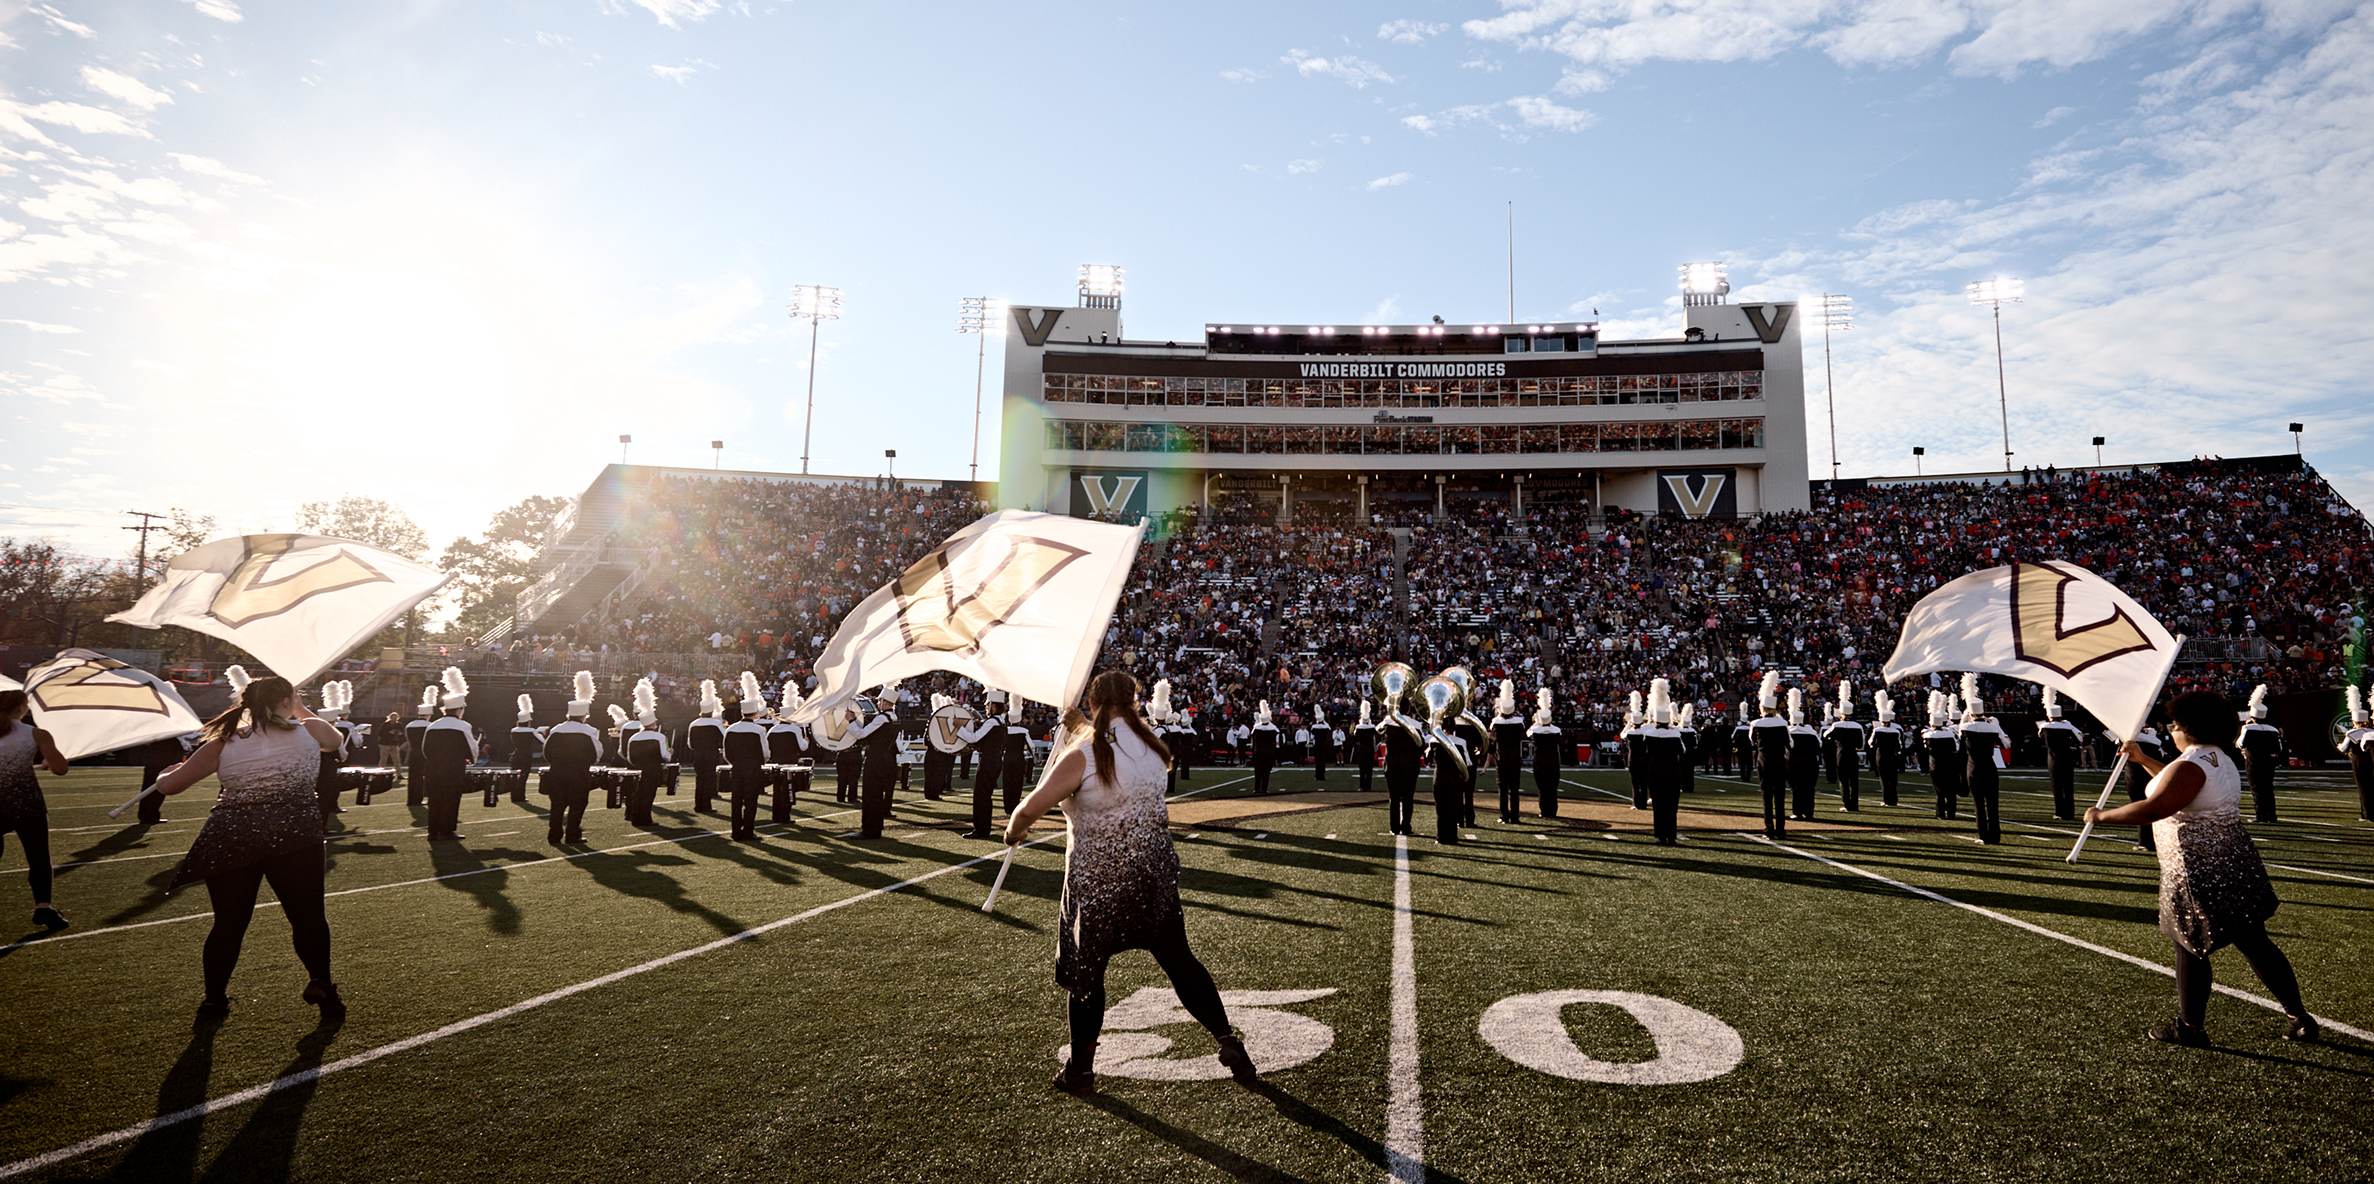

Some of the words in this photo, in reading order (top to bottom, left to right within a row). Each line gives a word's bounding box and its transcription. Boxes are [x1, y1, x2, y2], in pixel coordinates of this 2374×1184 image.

[1012, 308, 1064, 346] V
[1741, 304, 1796, 343] V
[1300, 363, 1393, 377] VANDERBILT
[1397, 362, 1506, 377] COMMODORES
[1080, 475, 1143, 516] V
[1219, 479, 1277, 488] VANDERBILT
[1662, 474, 1726, 520] V
[892, 534, 1091, 656] V
[935, 715, 972, 746] V
[2199, 751, 2220, 768] V
